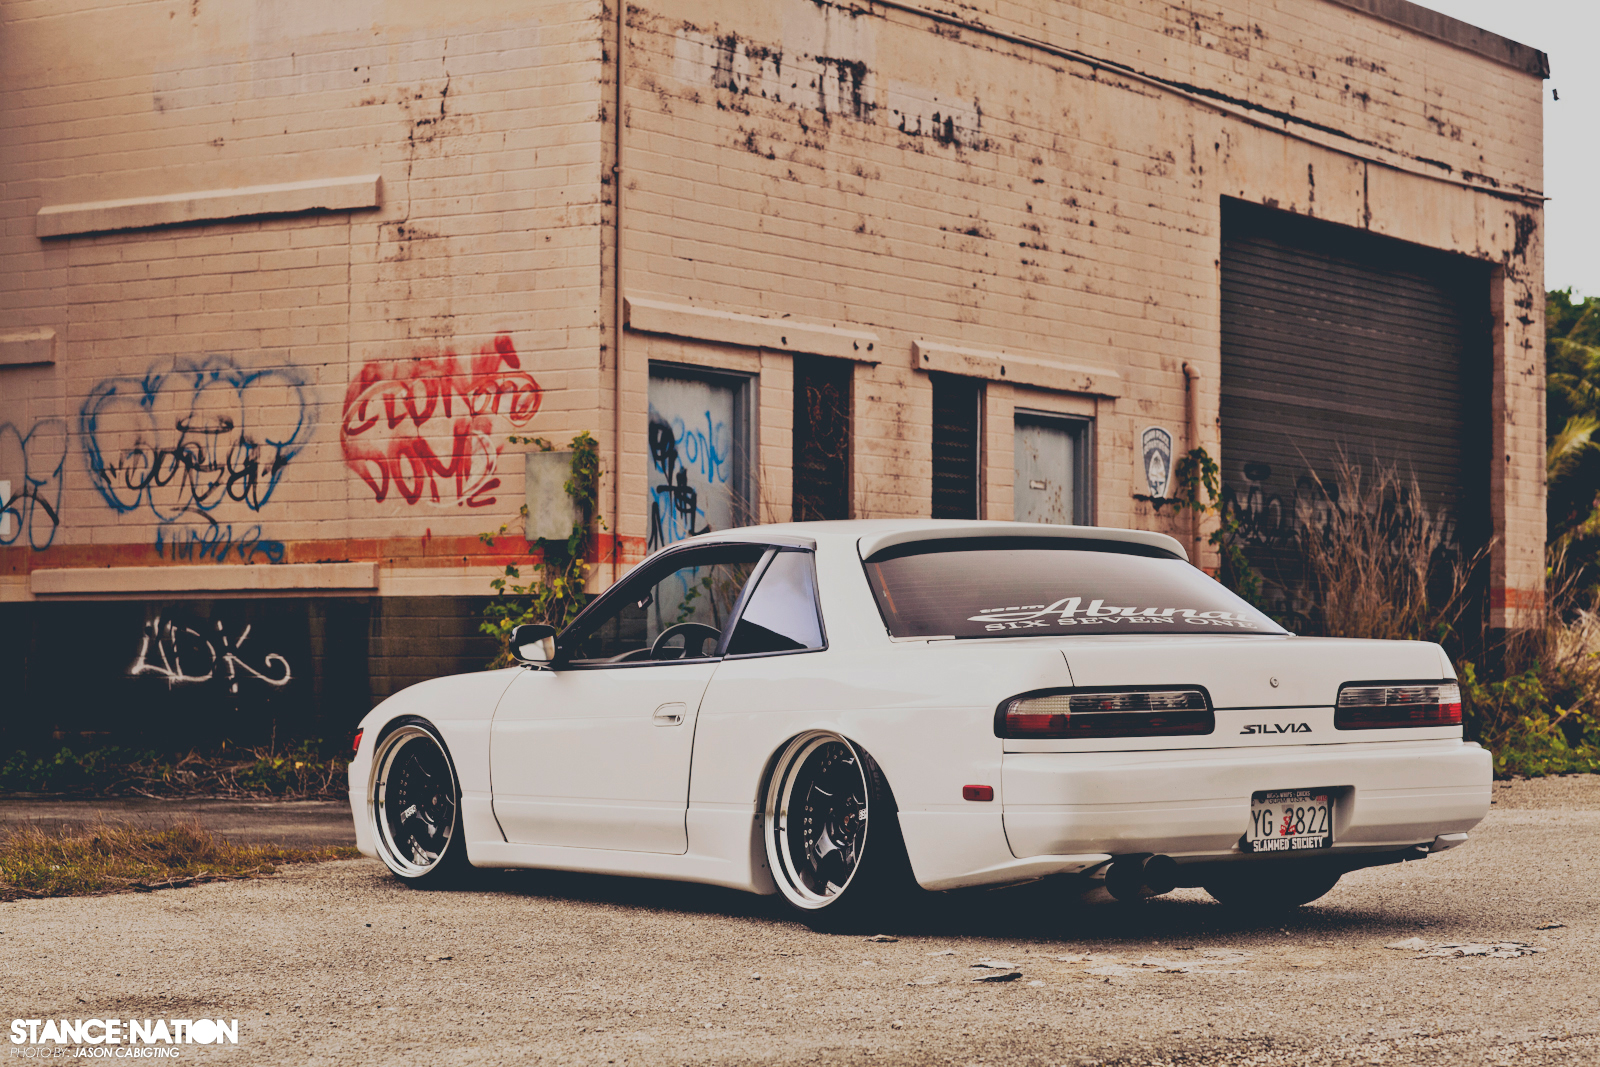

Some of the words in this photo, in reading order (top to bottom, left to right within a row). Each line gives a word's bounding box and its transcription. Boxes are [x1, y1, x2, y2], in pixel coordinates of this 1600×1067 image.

[984, 619, 1051, 632] SIX
[1057, 616, 1175, 626] SEVEN
[1184, 618, 1258, 630] ONE
[1239, 722, 1313, 735] SILVIA
[1251, 808, 1273, 838] YG
[1284, 805, 1328, 836] 2822
[1253, 838, 1290, 853] SLAMMED
[1291, 836, 1324, 850] SOCIETY
